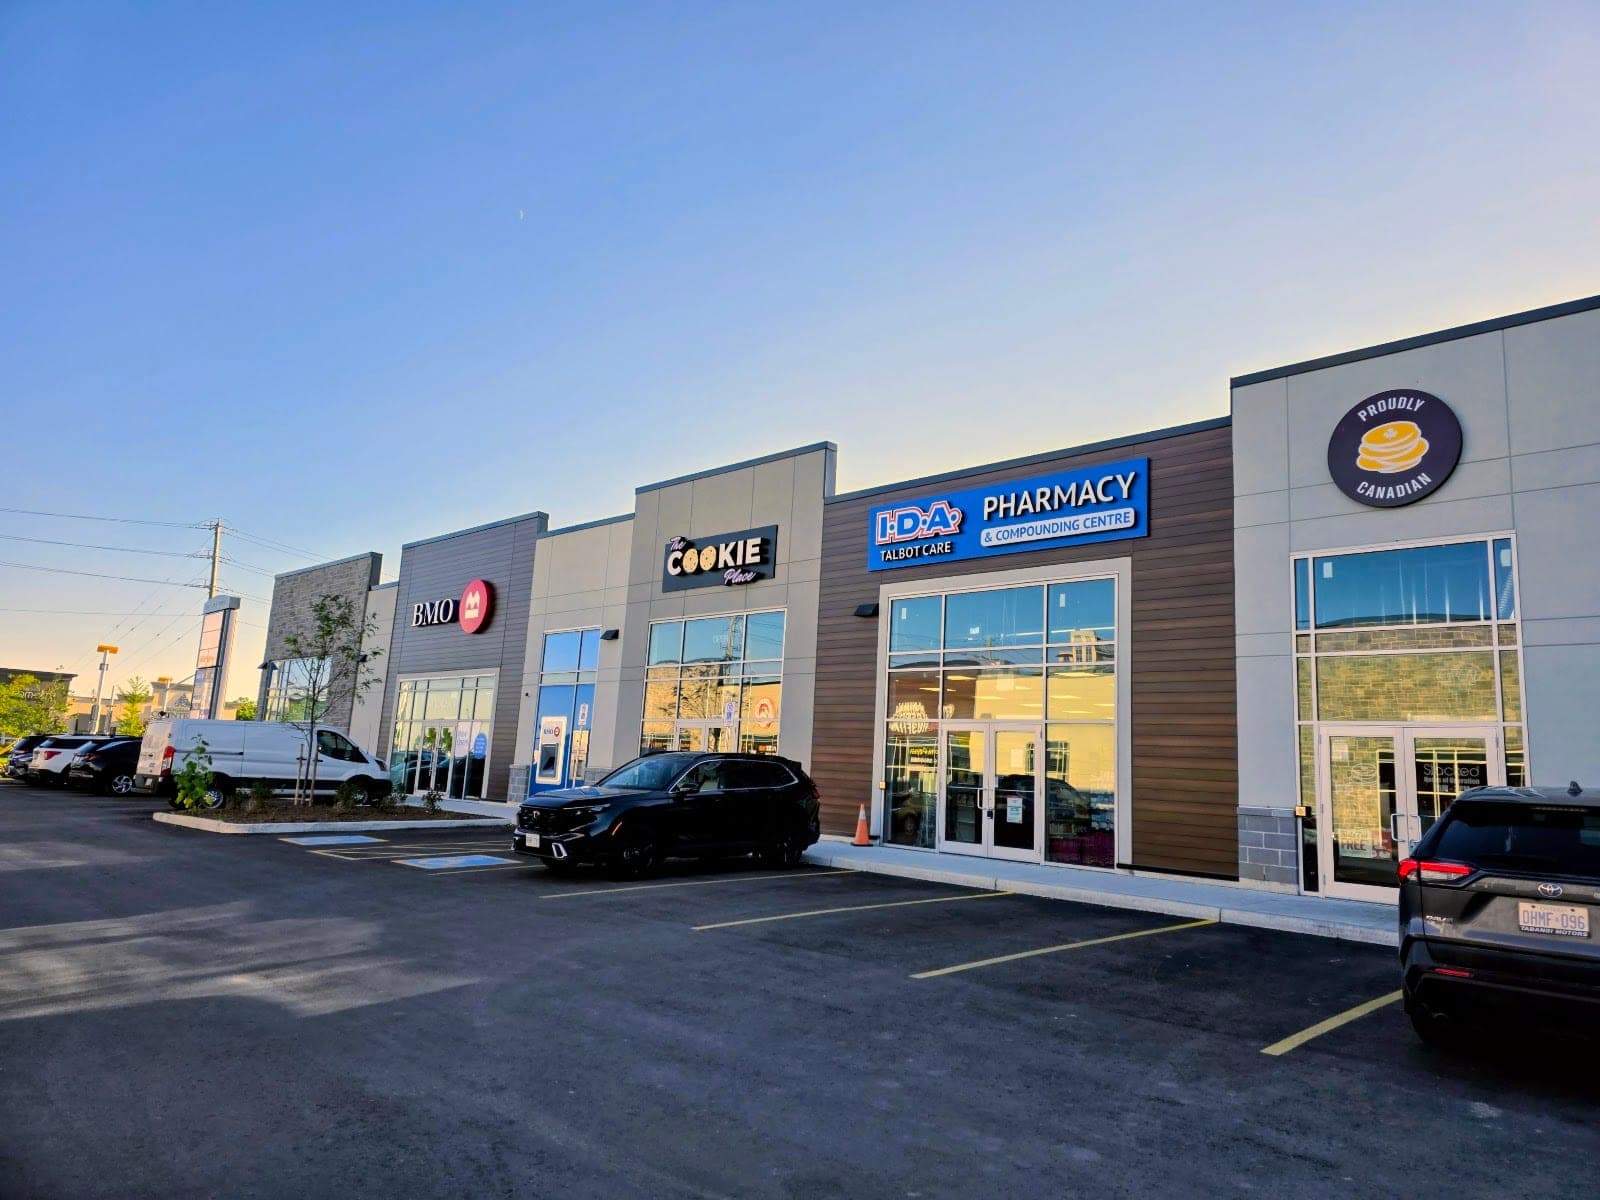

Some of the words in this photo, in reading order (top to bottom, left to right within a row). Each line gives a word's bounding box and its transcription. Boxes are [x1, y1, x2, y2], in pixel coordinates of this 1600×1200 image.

[1357, 396, 1425, 422] PROUDLY
[983, 471, 1135, 521] PHARMACY
[1356, 472, 1432, 499] CANADIAN
[984, 532, 993, 543] &
[995, 519, 1080, 541] COMPOUNDING
[1083, 511, 1131, 529] CENTRE
[667, 537, 762, 576] COOKIE
[669, 536, 687, 551] The
[880, 545, 921, 561] TALBOT
[922, 541, 952, 556] CARE
[723, 568, 758, 585] Place
[410, 598, 454, 628] BMO
[1423, 763, 1480, 777] Staced
